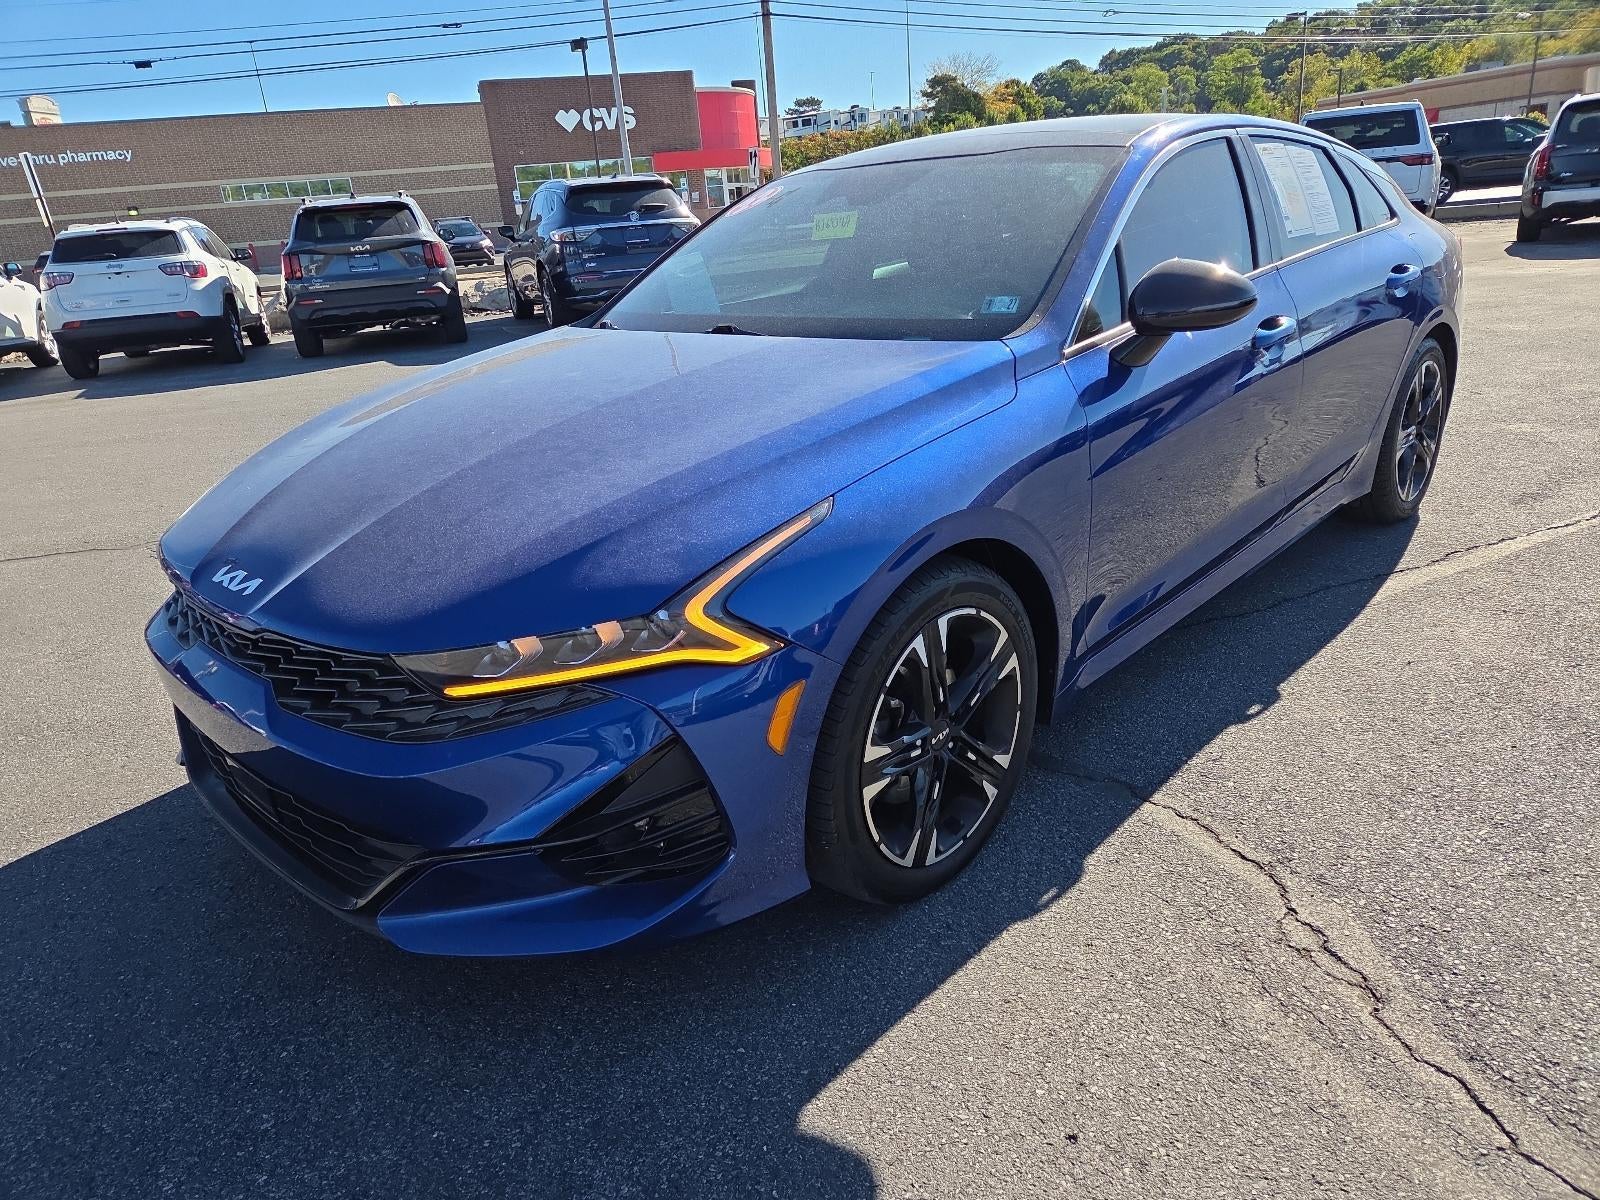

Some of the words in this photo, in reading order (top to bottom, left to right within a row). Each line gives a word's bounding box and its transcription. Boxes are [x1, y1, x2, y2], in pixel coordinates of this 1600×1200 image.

[582, 105, 637, 132] CVS
[58, 150, 132, 166] pharmacy
[212, 564, 264, 596] KIA
